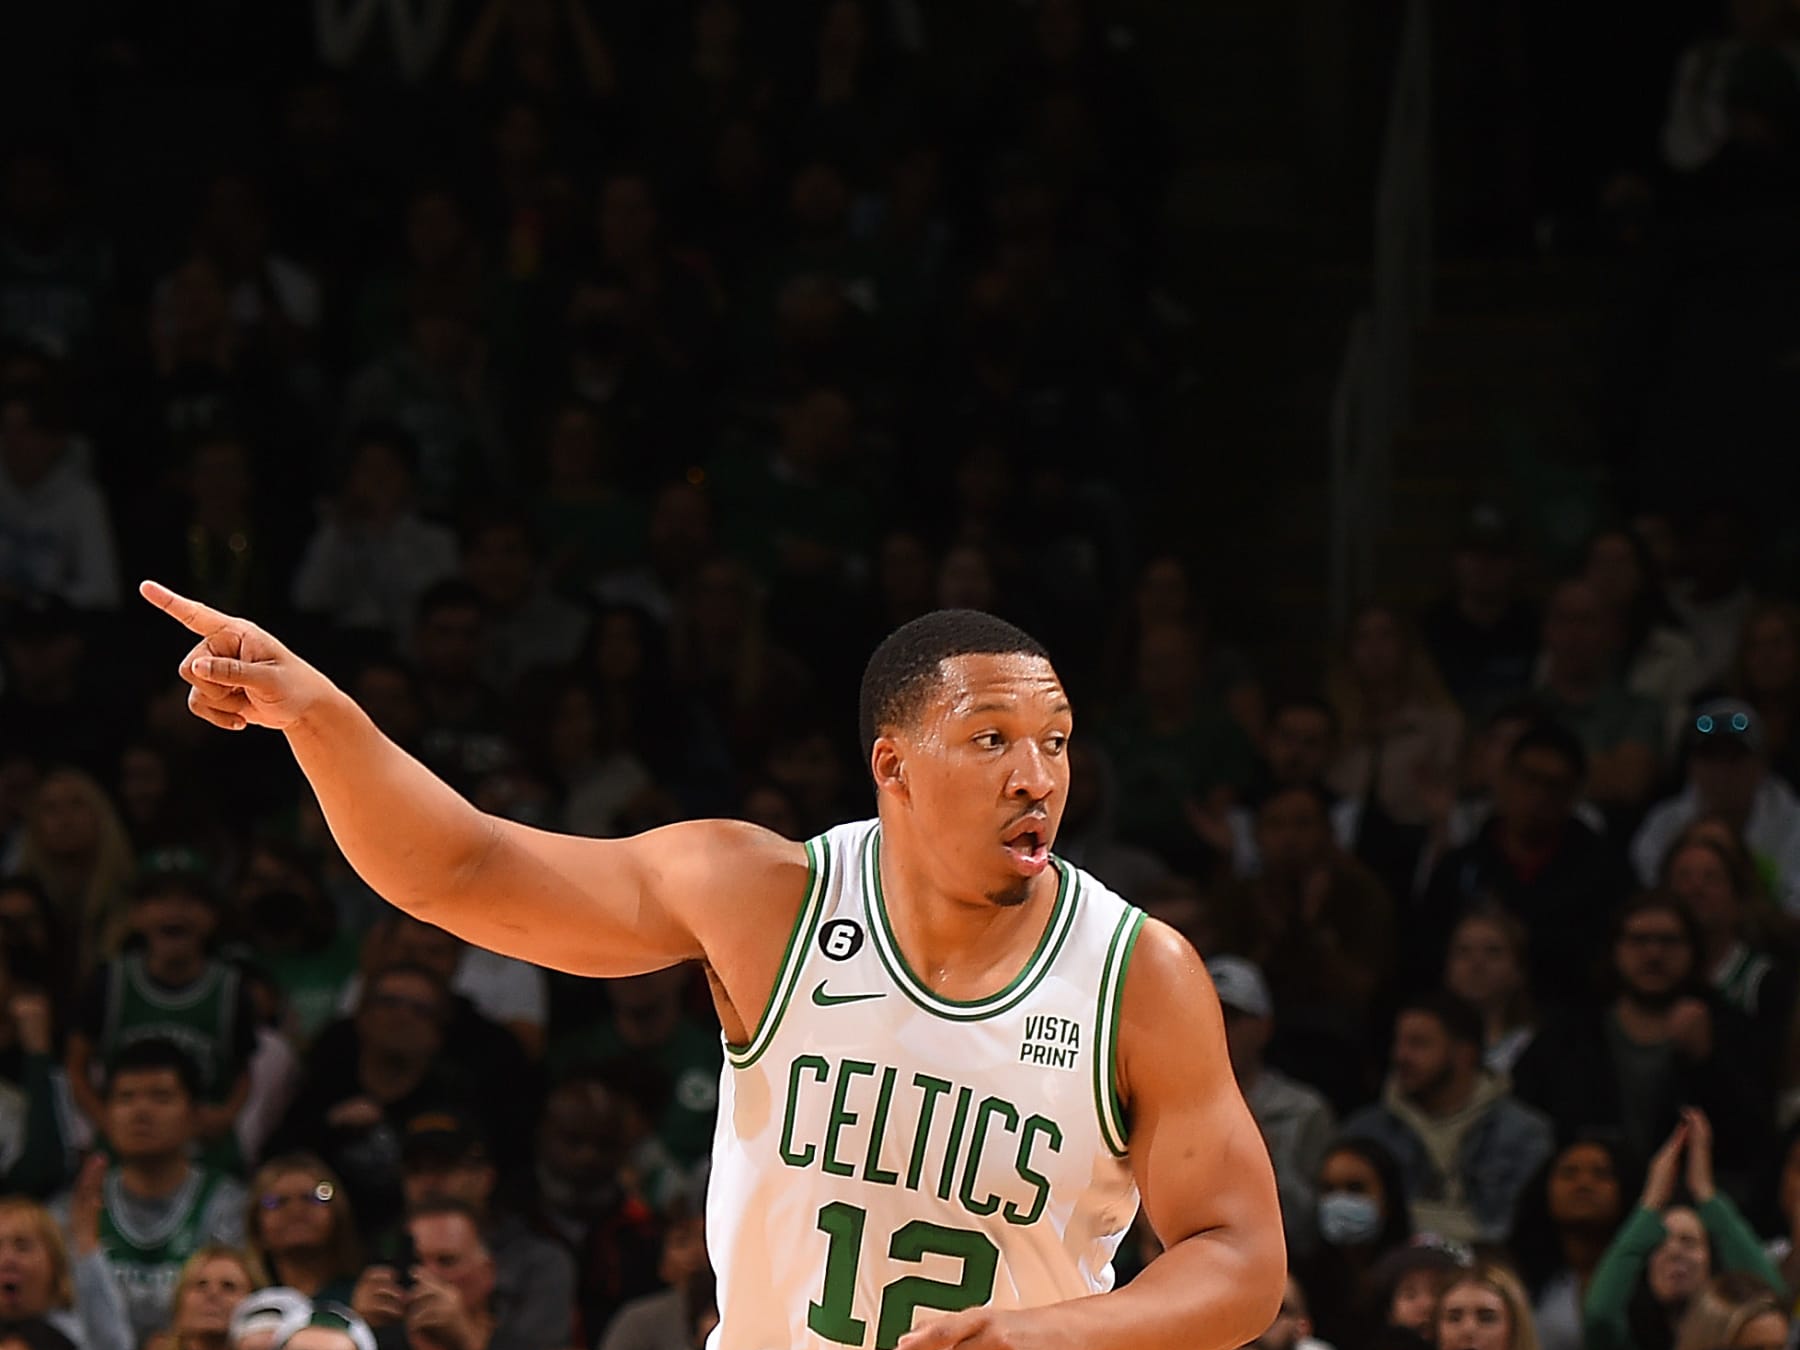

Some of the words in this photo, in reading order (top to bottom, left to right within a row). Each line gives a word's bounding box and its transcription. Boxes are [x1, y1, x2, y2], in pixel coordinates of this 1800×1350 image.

[826, 924, 856, 957] 6
[1025, 1015, 1080, 1049] VISTA
[1020, 1043, 1079, 1069] PRINT
[778, 1055, 1063, 1225] CELTICS
